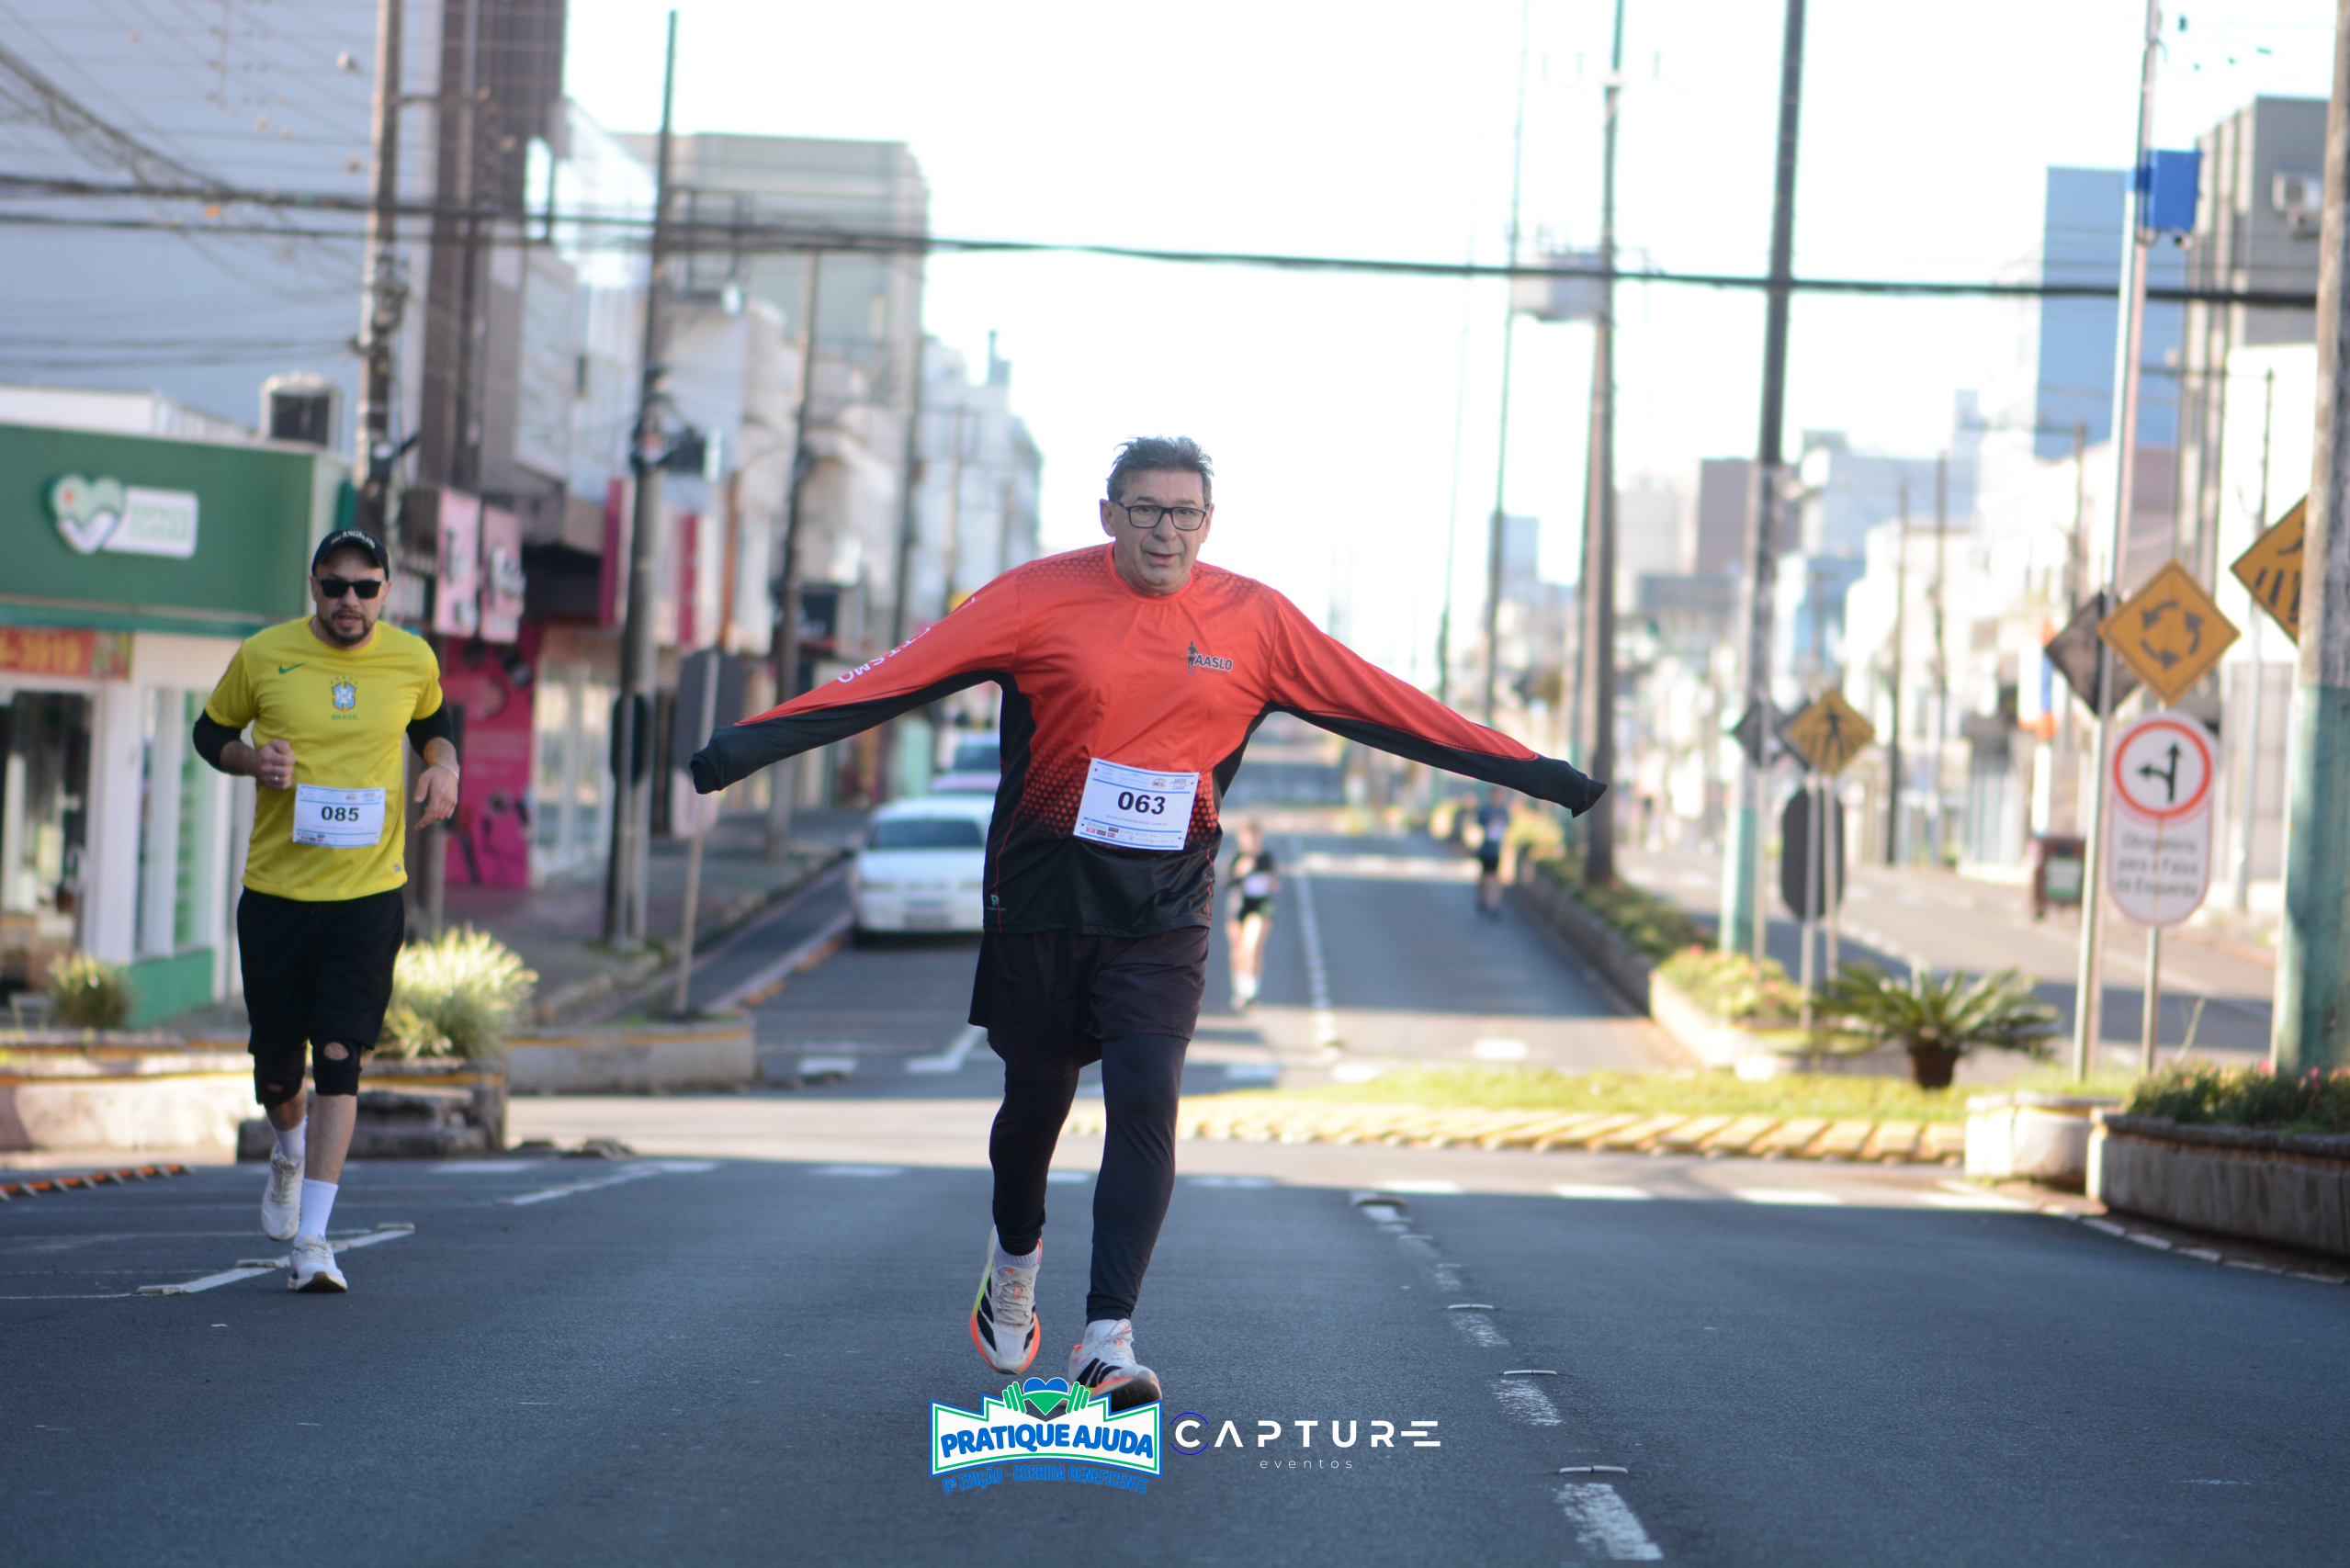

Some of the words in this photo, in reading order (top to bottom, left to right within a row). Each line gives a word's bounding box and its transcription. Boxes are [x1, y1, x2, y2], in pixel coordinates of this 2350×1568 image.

[1194, 653, 1233, 671] AASLO
[1117, 791, 1166, 815] 063
[322, 806, 359, 822] 085
